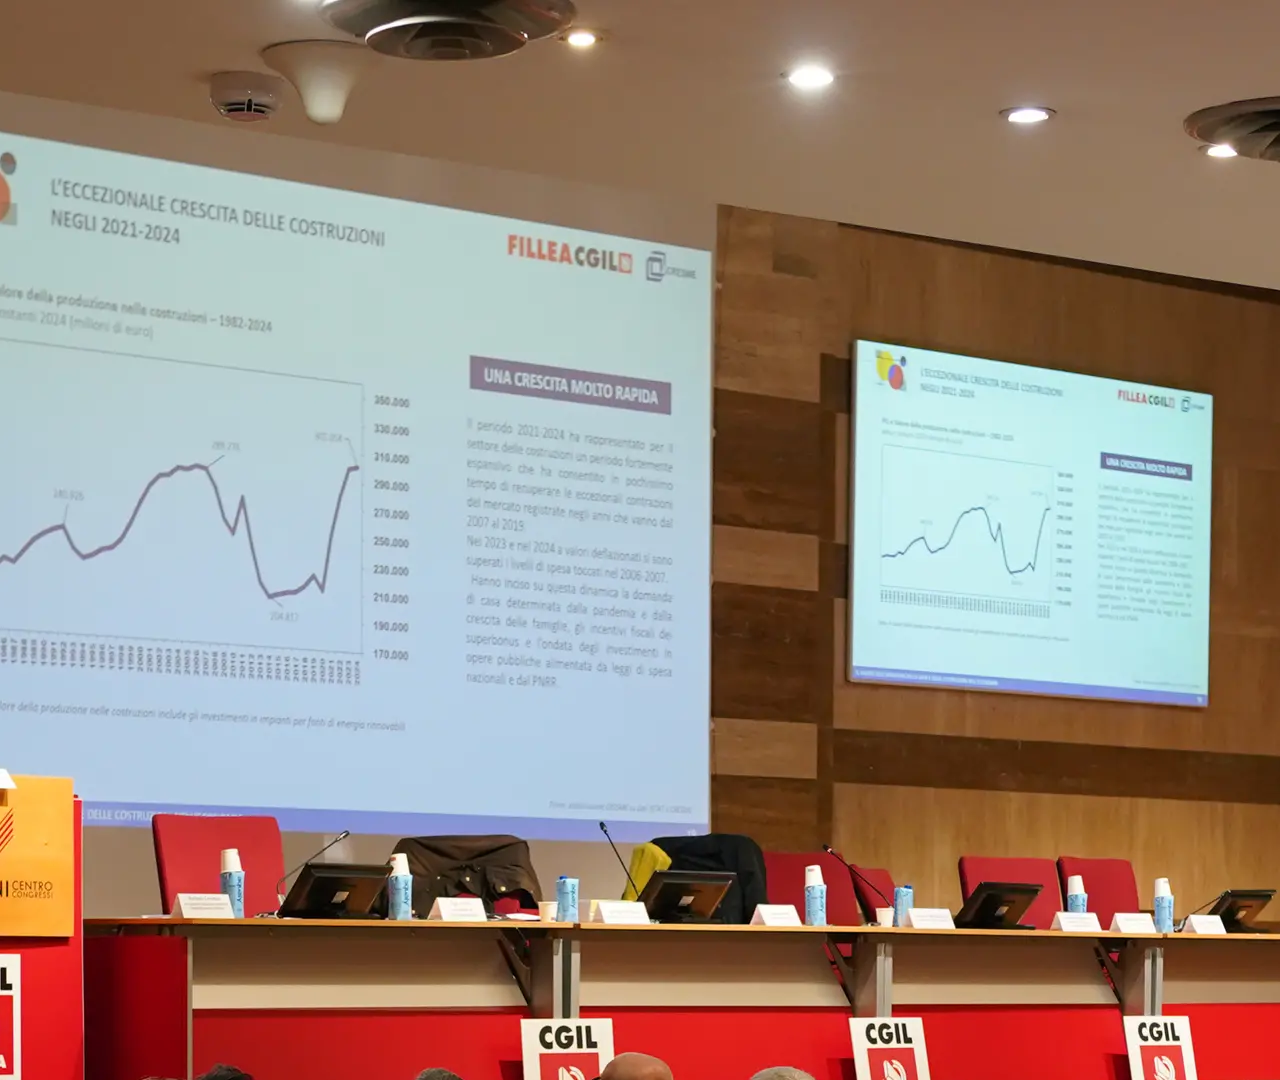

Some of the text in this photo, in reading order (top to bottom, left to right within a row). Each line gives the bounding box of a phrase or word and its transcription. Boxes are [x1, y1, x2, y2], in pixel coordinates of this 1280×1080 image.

[51, 178, 386, 247] L'ECCEZIONALE CRESCITA DELLE COSTRUZIONI
[51, 209, 181, 245] NEGLI 2021-2024
[26, 287, 54, 304] della
[57, 292, 118, 313] produzione
[121, 301, 148, 317] nelle
[150, 307, 207, 325] costruzioni
[219, 313, 273, 333] 1982-2024
[40, 311, 67, 327] 2024
[483, 366, 659, 405] UNA CRESCITA MOLTO RAPIDA
[87, 808, 112, 820] DELLE
[12, 880, 53, 892] CENTRO
[12, 890, 53, 899] CONGRESSI
[539, 1025, 598, 1049] CGIL
[865, 1023, 913, 1044] CGIL
[1138, 1022, 1180, 1041] CGIL
